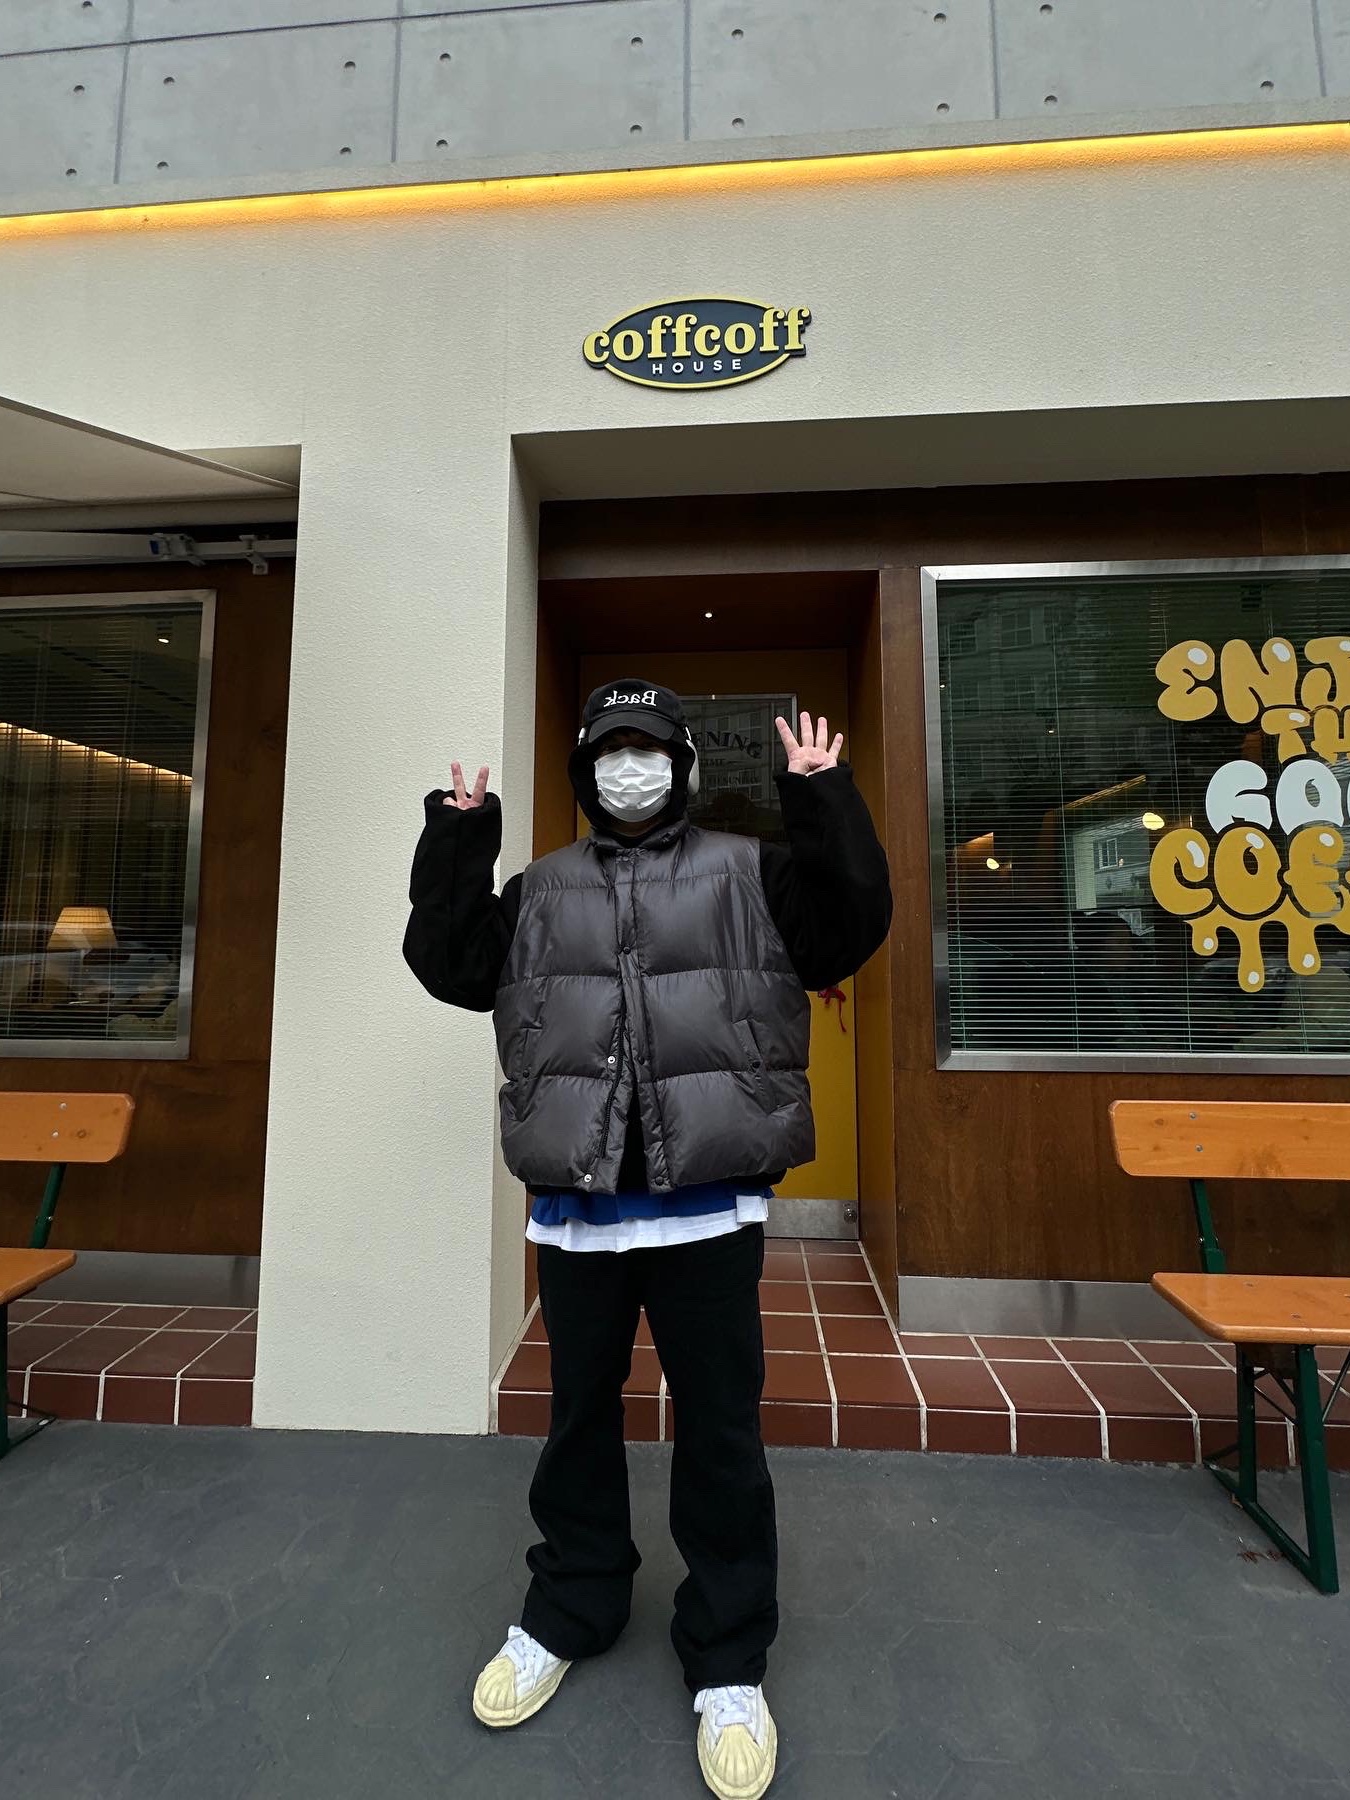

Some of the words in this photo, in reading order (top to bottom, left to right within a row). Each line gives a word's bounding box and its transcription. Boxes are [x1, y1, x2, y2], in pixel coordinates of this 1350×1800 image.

[583, 306, 810, 363] coffcoff
[652, 359, 742, 374] HOUSE
[691, 730, 763, 759] ENING
[1205, 759, 1350, 836] GO
[1149, 826, 1350, 917] COF
